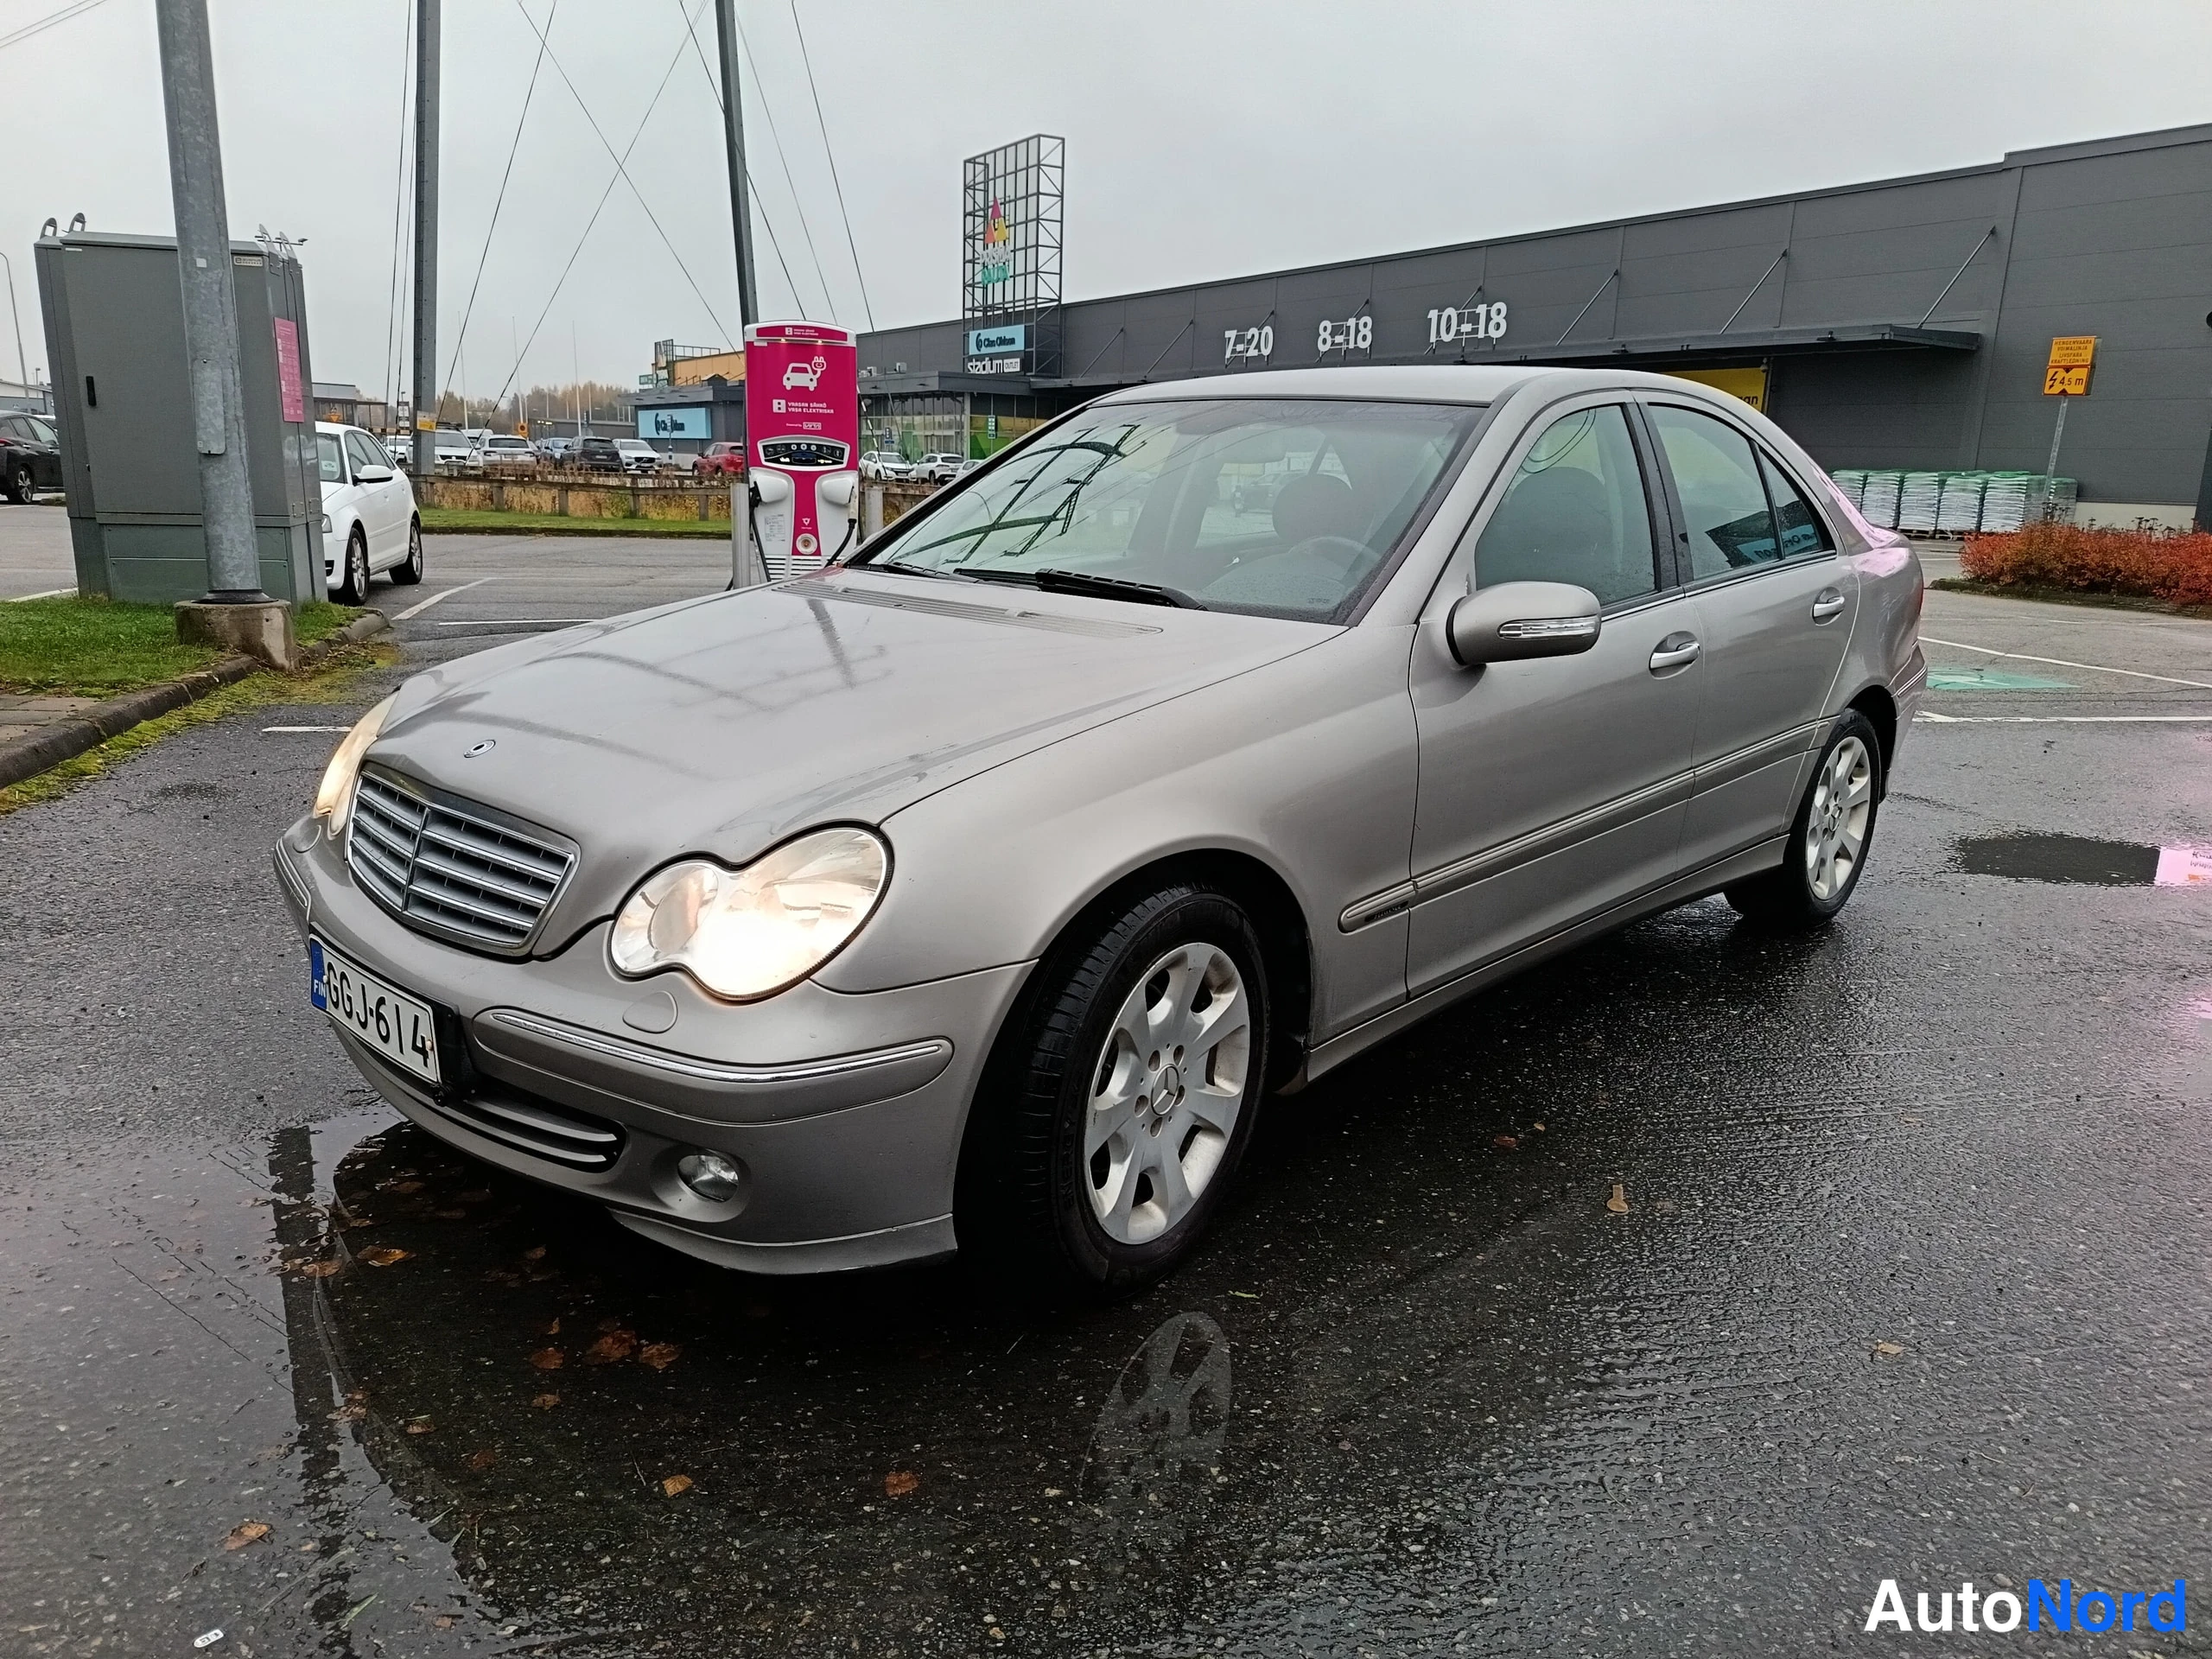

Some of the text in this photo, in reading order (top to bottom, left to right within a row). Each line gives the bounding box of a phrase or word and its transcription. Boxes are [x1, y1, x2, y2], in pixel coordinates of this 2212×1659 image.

[1317, 315, 1373, 353] 8-18
[1427, 302, 1508, 344] 10-18
[1224, 325, 1274, 358] 7-20
[968, 357, 1019, 374] stadium OUTLET
[314, 979, 327, 998] FIN
[327, 962, 429, 1068] GGJ-614
